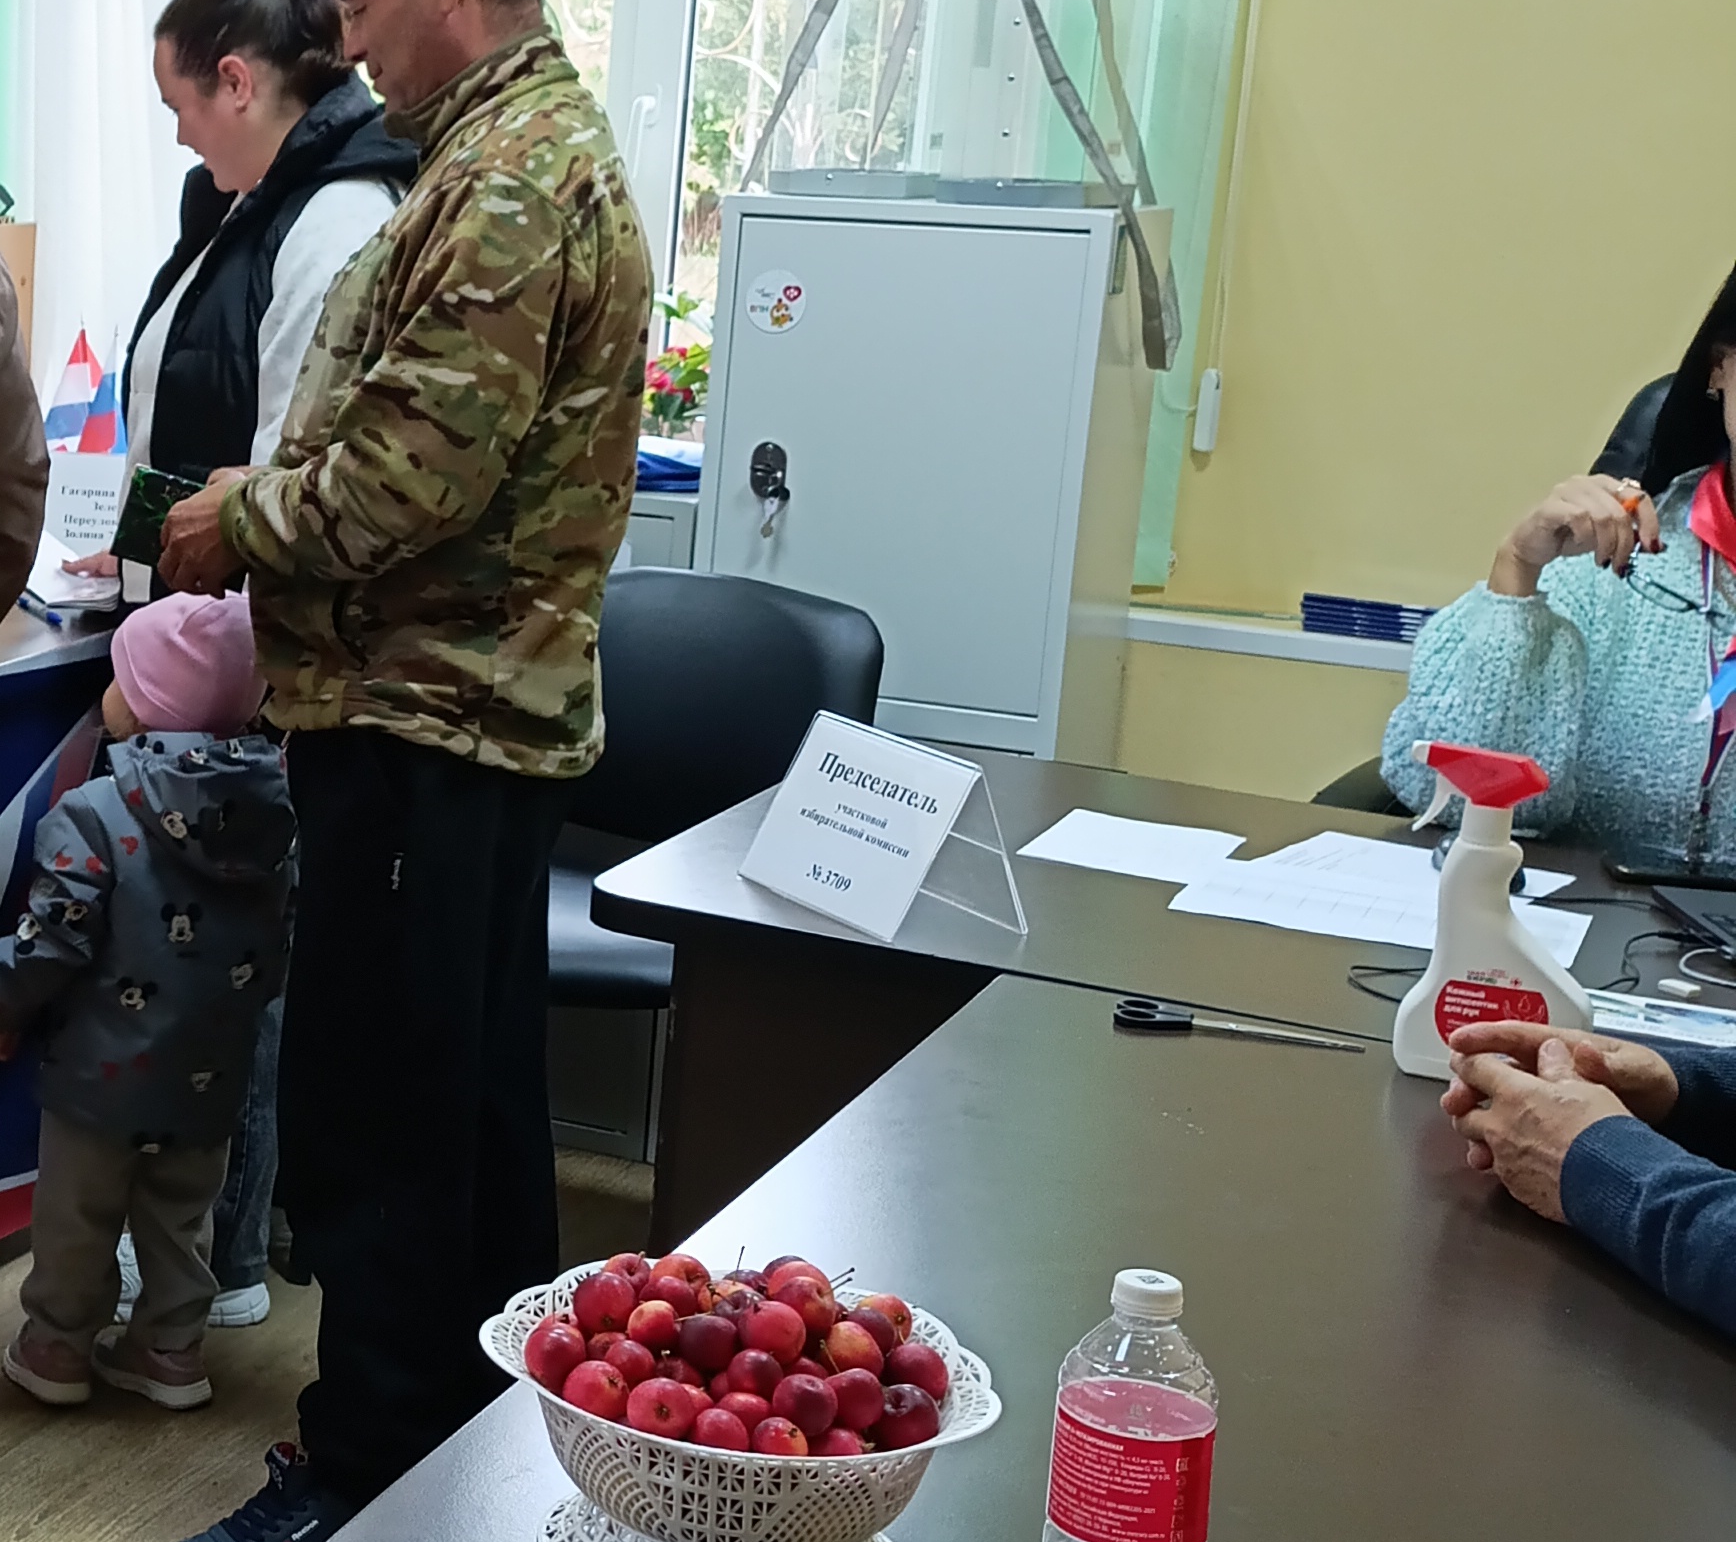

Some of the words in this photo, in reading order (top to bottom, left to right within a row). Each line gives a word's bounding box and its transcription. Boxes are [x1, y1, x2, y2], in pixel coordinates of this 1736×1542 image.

[61, 486, 115, 498] Гагарина
[817, 752, 940, 816] Председатель
[834, 803, 889, 830] участковой
[799, 807, 864, 840] избирательной
[864, 831, 910, 859] комиссии
[805, 864, 822, 881] №
[821, 869, 852, 893] 3709
[1462, 1007, 1481, 1018] рук
[291, 1519, 320, 1541] Reebok
